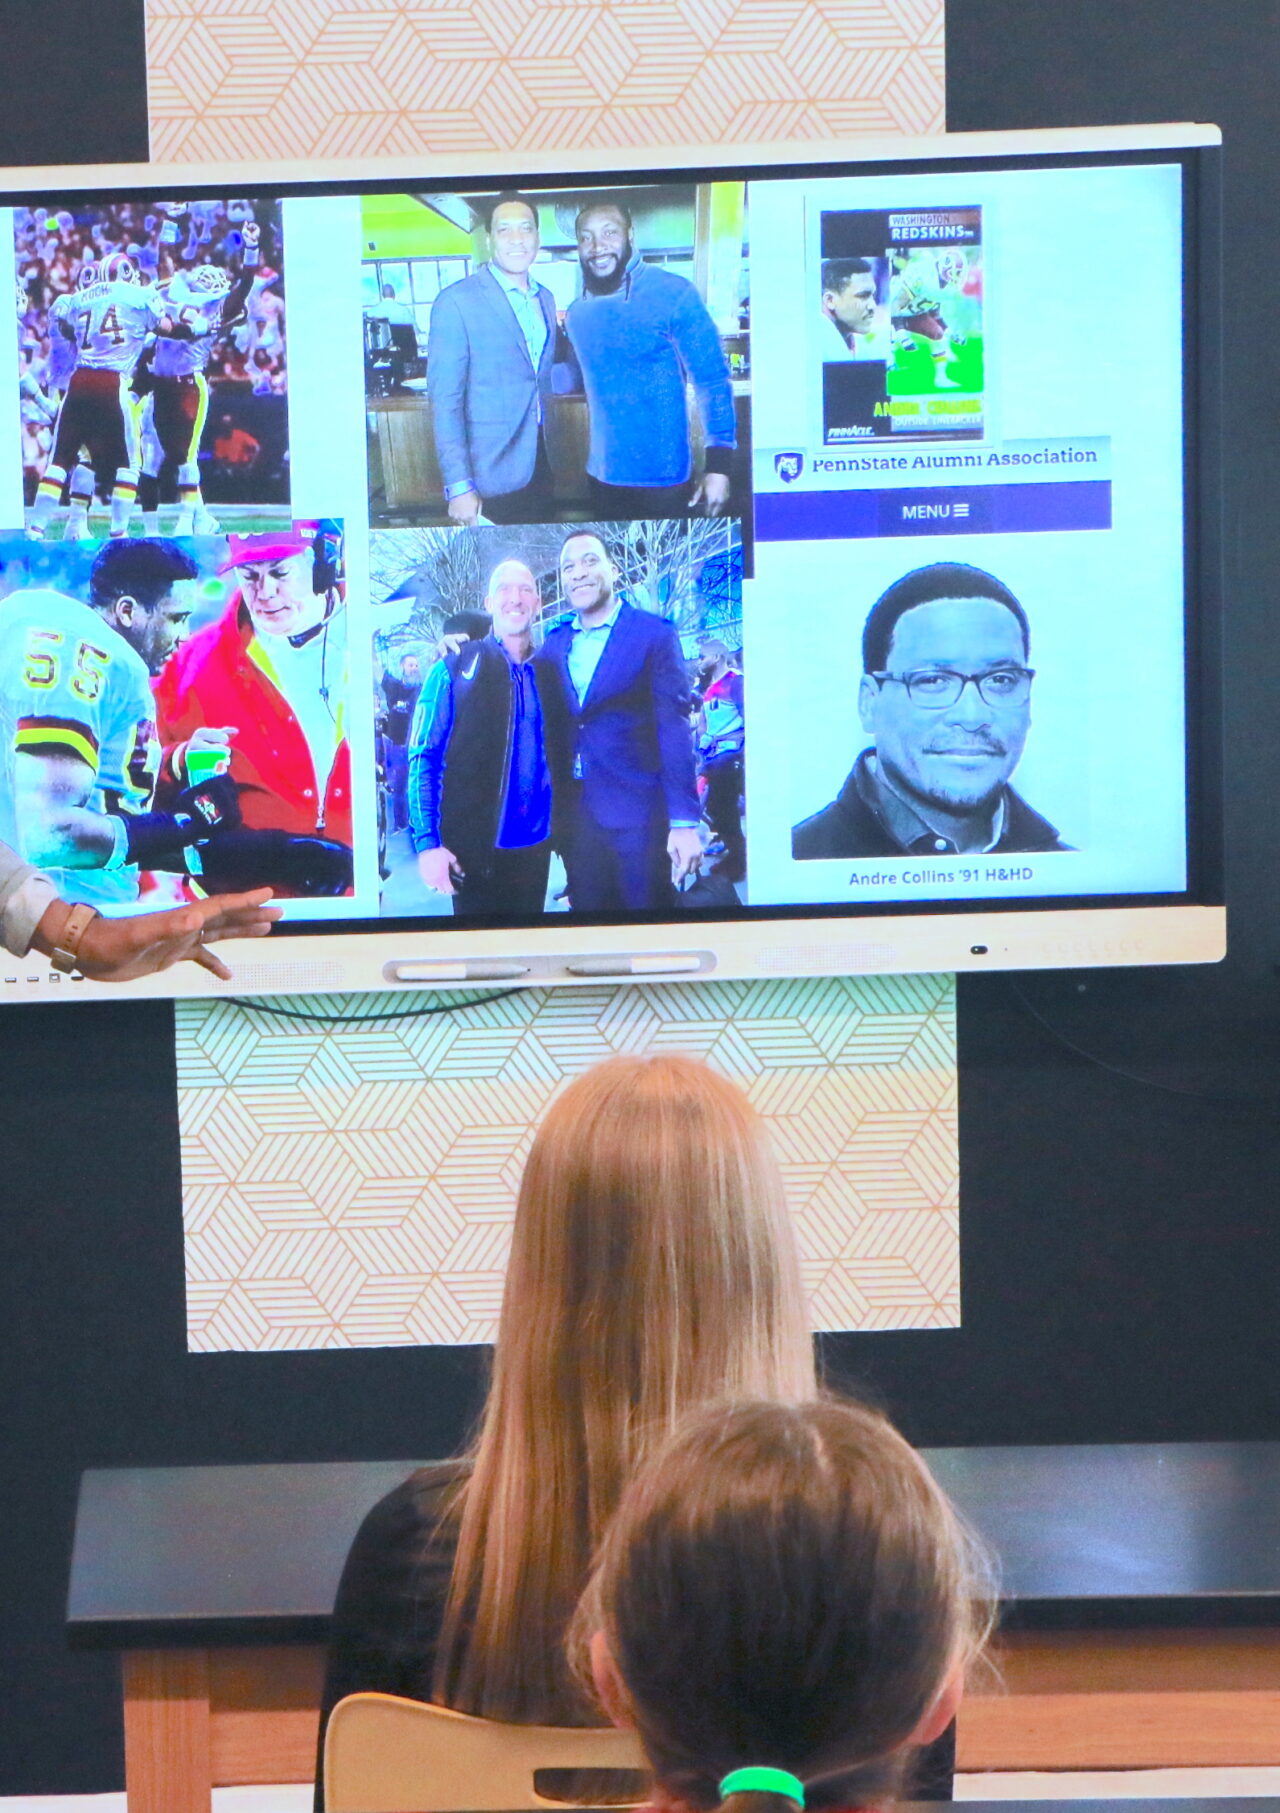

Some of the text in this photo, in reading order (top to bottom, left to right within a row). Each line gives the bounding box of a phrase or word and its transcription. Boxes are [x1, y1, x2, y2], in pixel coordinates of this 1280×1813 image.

[892, 214, 950, 225] WASHINGTON
[78, 303, 125, 351] 74
[812, 447, 1098, 473] PennState Alumni Association
[902, 504, 950, 519] MENU
[23, 629, 111, 703] 55
[849, 867, 1034, 886] Andre Collins '91 H&HD
